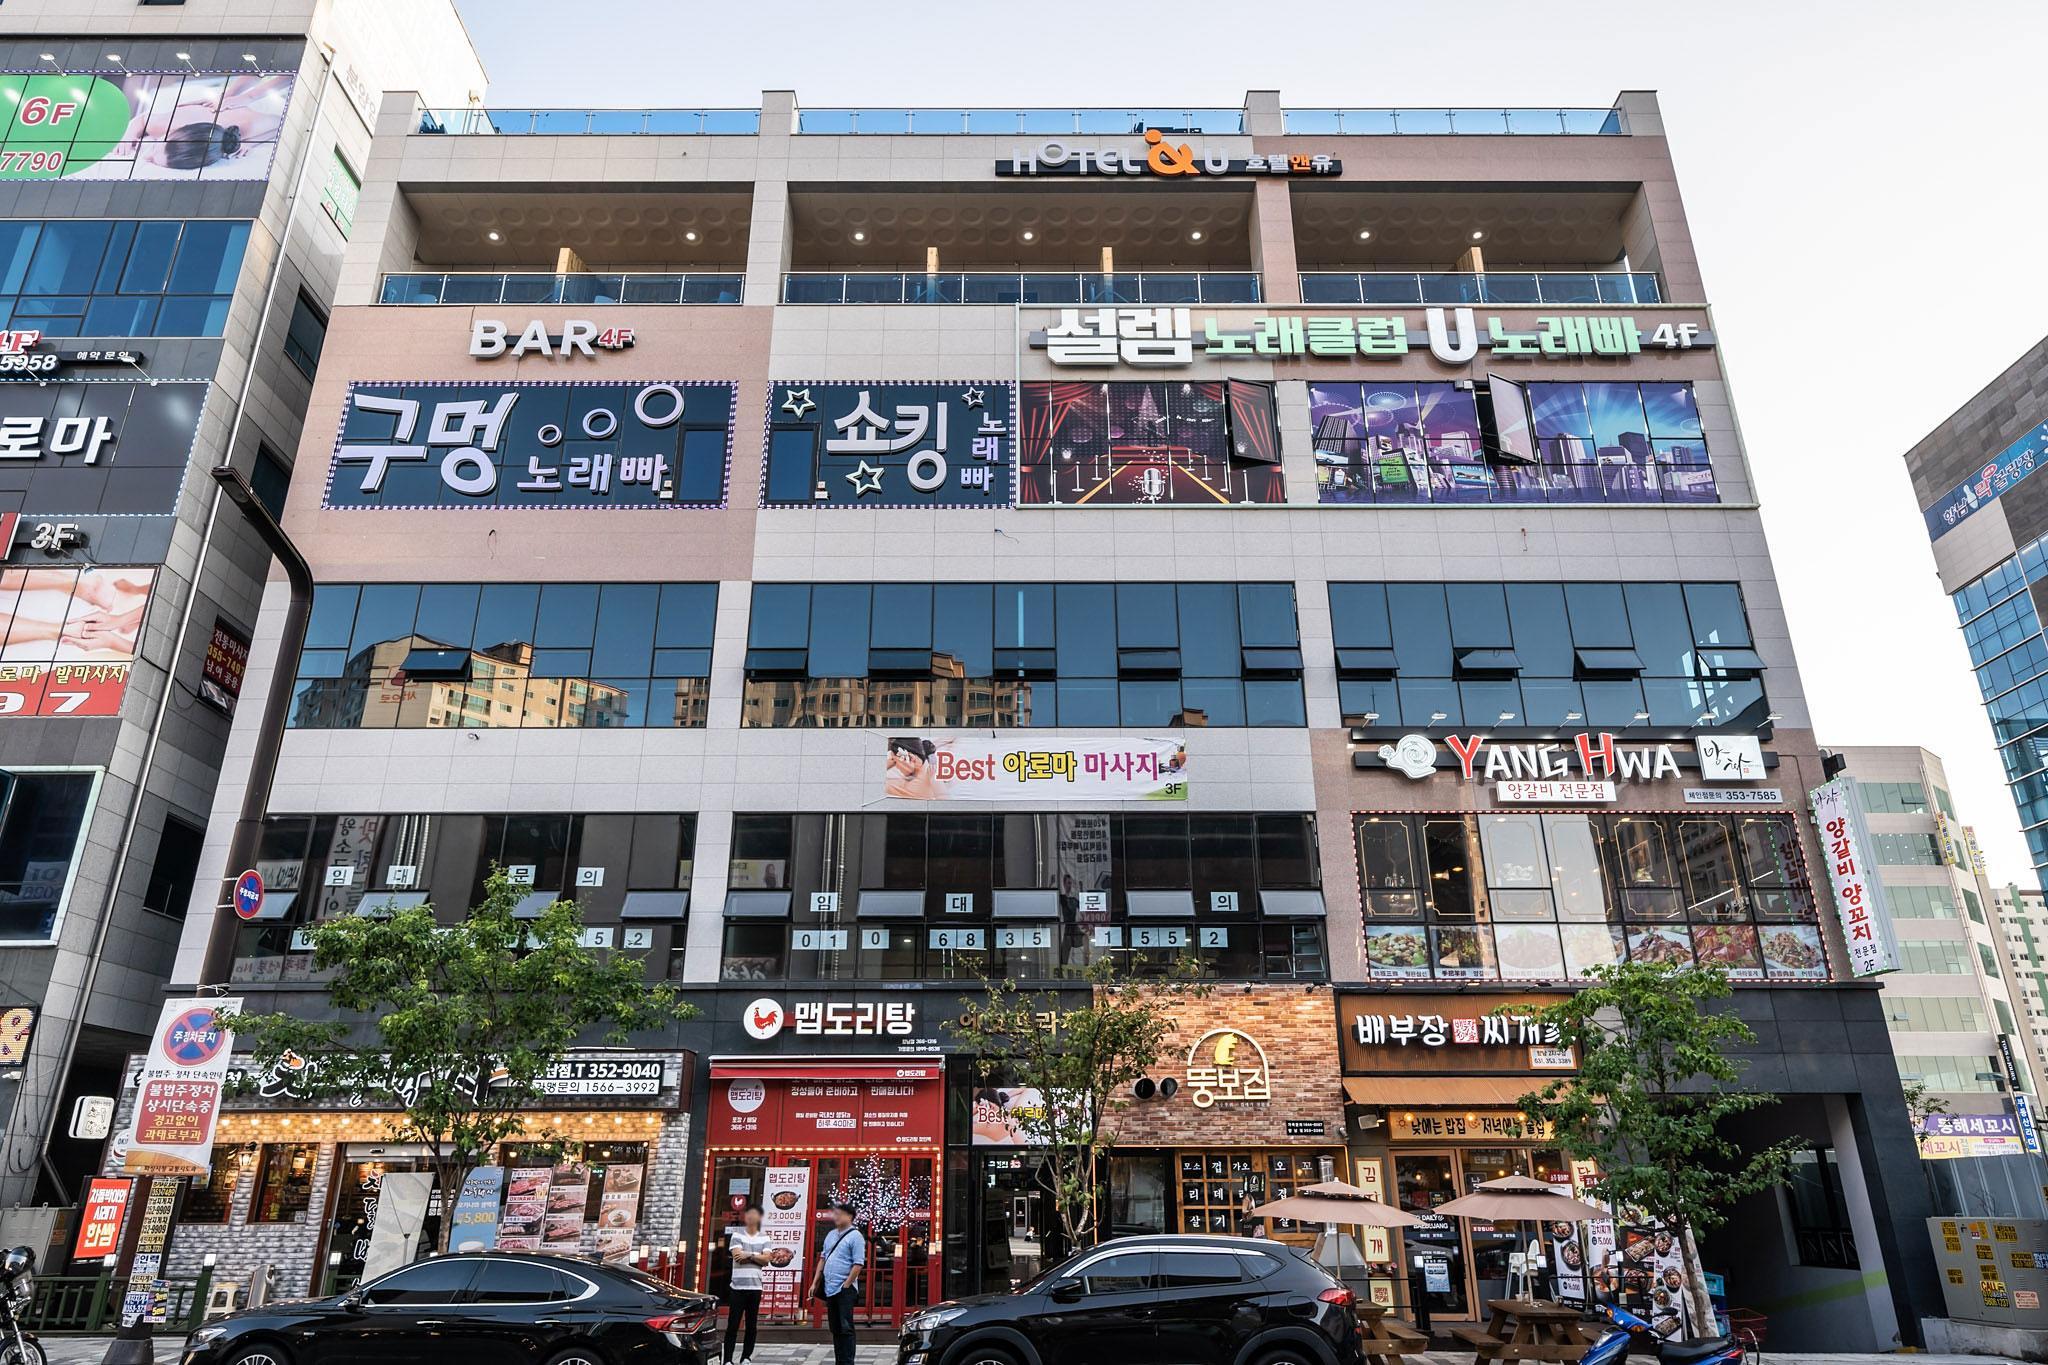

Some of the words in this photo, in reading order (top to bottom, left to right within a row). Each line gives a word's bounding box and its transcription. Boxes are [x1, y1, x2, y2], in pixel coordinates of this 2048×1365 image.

[20, 97, 75, 126] 6F
[0, 151, 63, 172] 7790
[1012, 143, 1142, 175] HOTEL
[1244, 153, 1334, 174] 호텔앤유
[469, 318, 599, 357] BAR
[597, 327, 636, 349] 4F
[1047, 308, 1193, 367] 설렘
[1204, 316, 1409, 355] 노래클럽
[1426, 308, 1479, 365] U
[1487, 316, 1642, 356] 노래빠
[1651, 322, 1699, 349] 4F
[76, 351, 101, 361] 예약
[337, 392, 519, 496] 구멍
[517, 453, 669, 495] 노래빠
[826, 391, 948, 493] 쇼킹
[960, 412, 1007, 495] 노래빠
[31, 522, 79, 550] 3F
[0, 665, 42, 684] 로마
[55, 665, 129, 684] 발마사지
[1445, 734, 1569, 781] YANG
[1573, 732, 1682, 779] HWA
[935, 751, 996, 781] Best
[1003, 750, 1077, 782] 아로마
[1084, 751, 1159, 782] 마사지
[1165, 783, 1182, 795] 3F
[1507, 782, 1554, 799] 양갈비
[1559, 782, 1606, 799] 전문점
[1725, 791, 1777, 800] 353-7585
[1854, 943, 1878, 958] 전문점
[1864, 960, 1875, 972] 2F
[794, 1002, 916, 1035] 맵도리탕
[173, 1030, 217, 1043] 주정차금지
[1355, 1014, 1450, 1046] 배부장
[588, 1063, 661, 1079] 352-9040
[149, 1083, 216, 1098] 불법주정차
[585, 1082, 655, 1093] 1566-3992
[730, 1091, 763, 1101] 맵도리탕
[791, 1086, 823, 1096] 정성들여
[826, 1086, 858, 1096] 준비하고
[1187, 1067, 1271, 1109] 뚱보집
[145, 1099, 212, 1114] 상시단속중
[153, 1114, 199, 1127] 경고없이
[1410, 1117, 1442, 1136] 낮에는
[1445, 1117, 1466, 1135] 밥집
[1937, 1117, 2017, 1134] 동해세꼬시
[144, 1129, 202, 1141] 과태료부과
[769, 1172, 806, 1184] 맵도리탕
